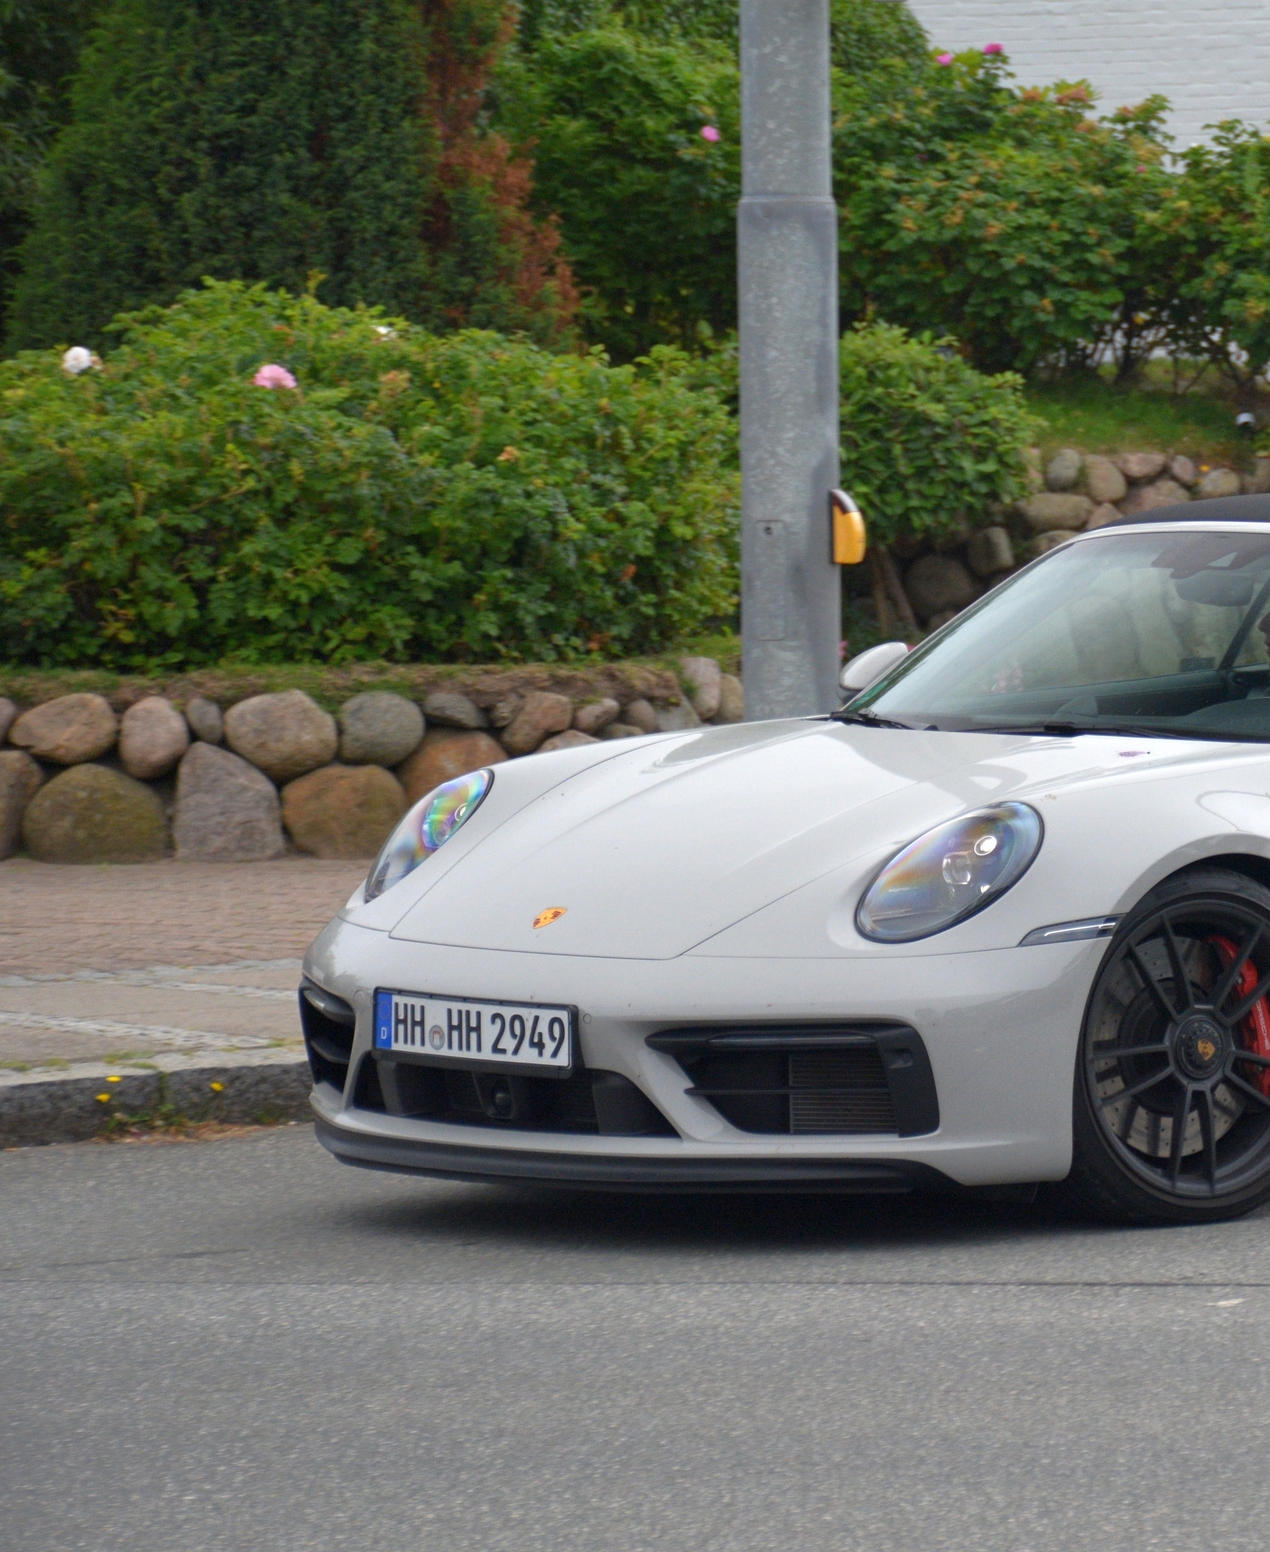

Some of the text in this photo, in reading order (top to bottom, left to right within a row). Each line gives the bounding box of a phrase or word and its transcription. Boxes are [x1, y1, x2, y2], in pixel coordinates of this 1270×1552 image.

[380, 1027, 388, 1040] D
[394, 1001, 566, 1059] HH HH 2949
